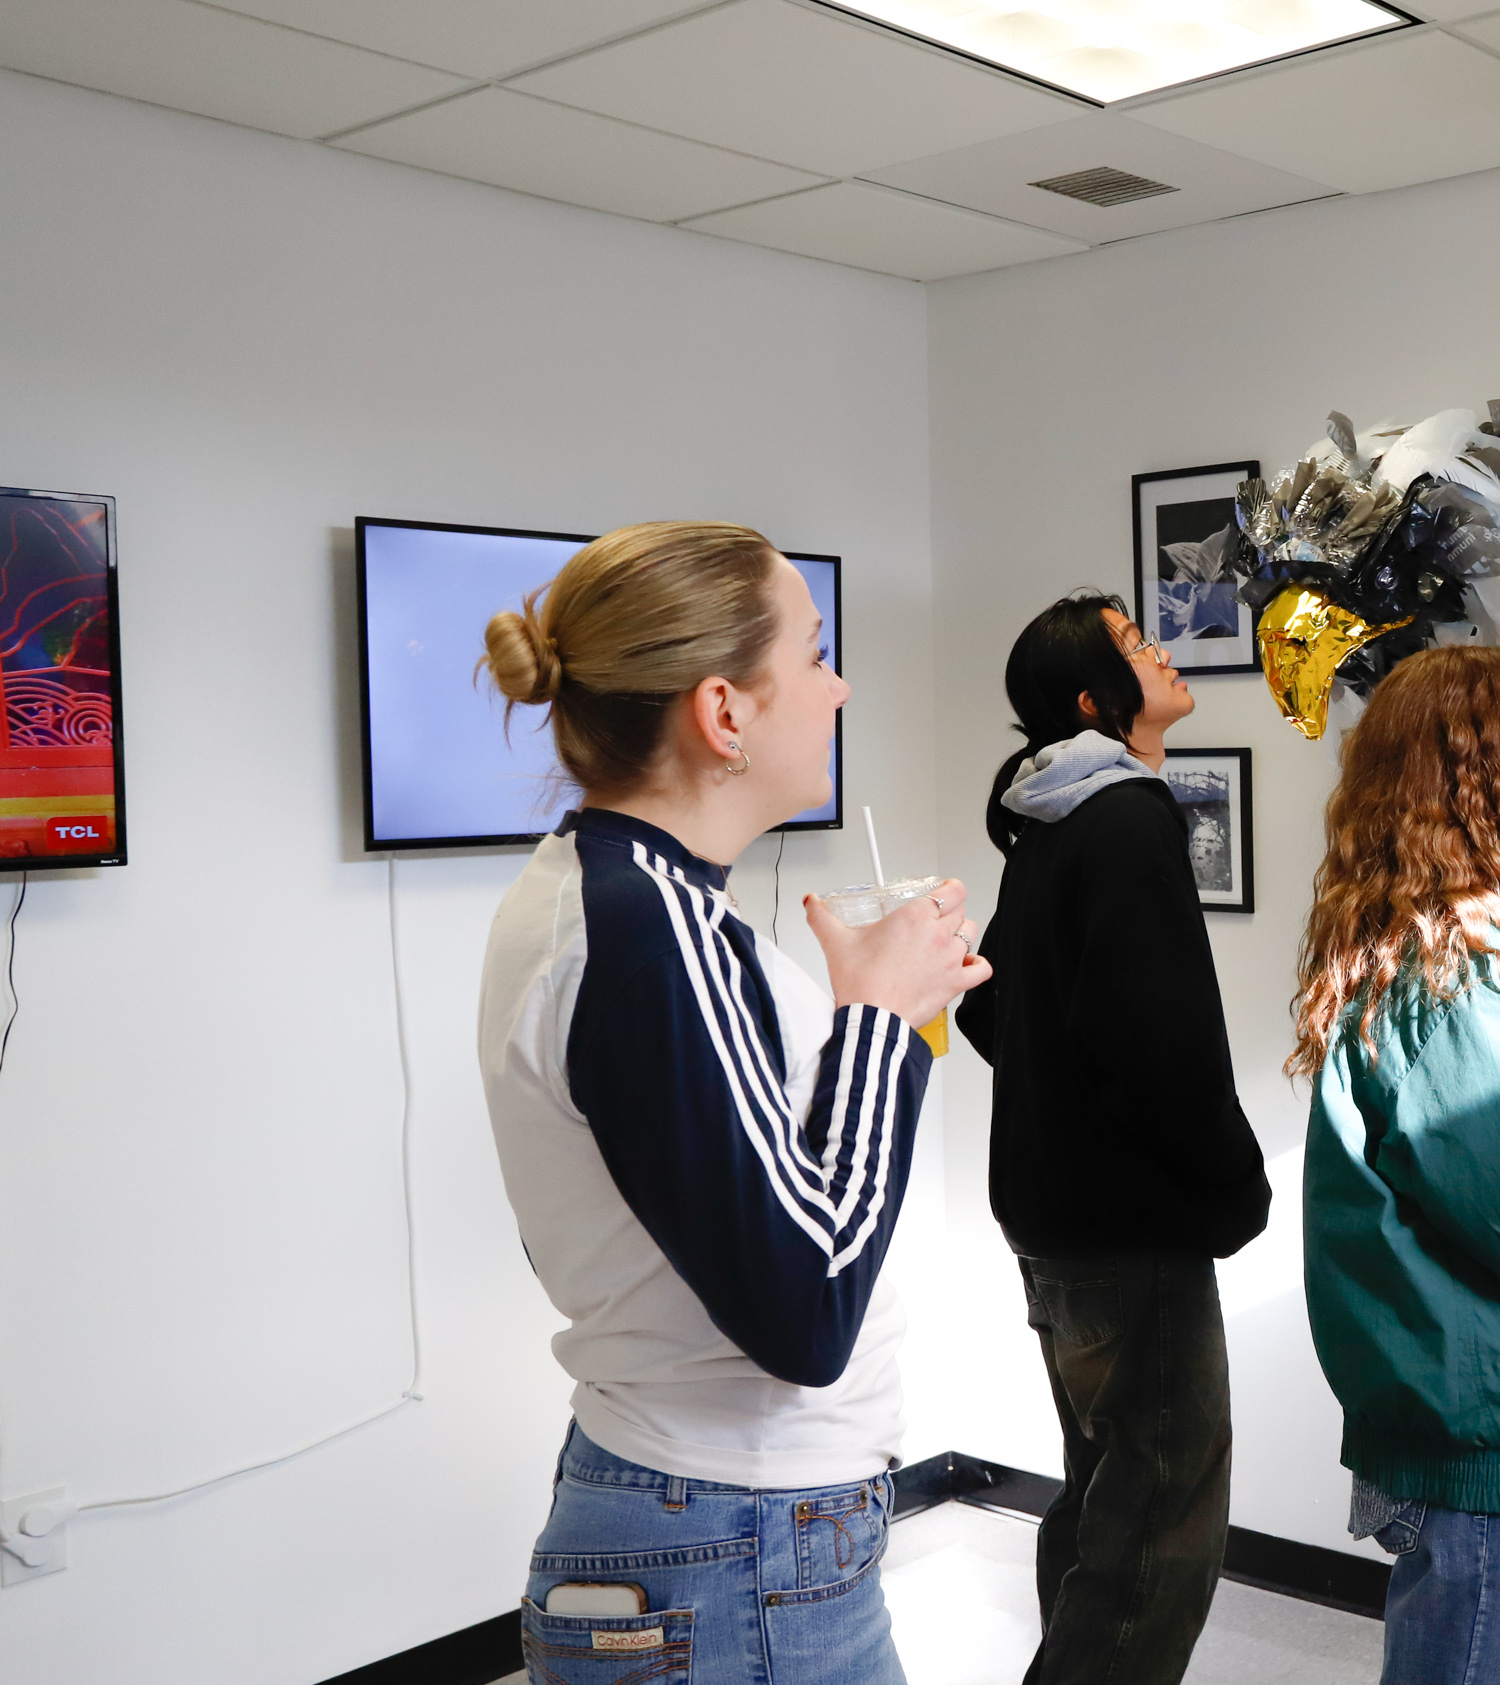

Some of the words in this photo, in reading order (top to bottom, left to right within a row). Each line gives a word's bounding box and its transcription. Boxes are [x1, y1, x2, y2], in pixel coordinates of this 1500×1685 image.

[55, 825, 99, 838] TCL
[597, 1635, 629, 1646] Calvin
[630, 1634, 657, 1646] Klein
